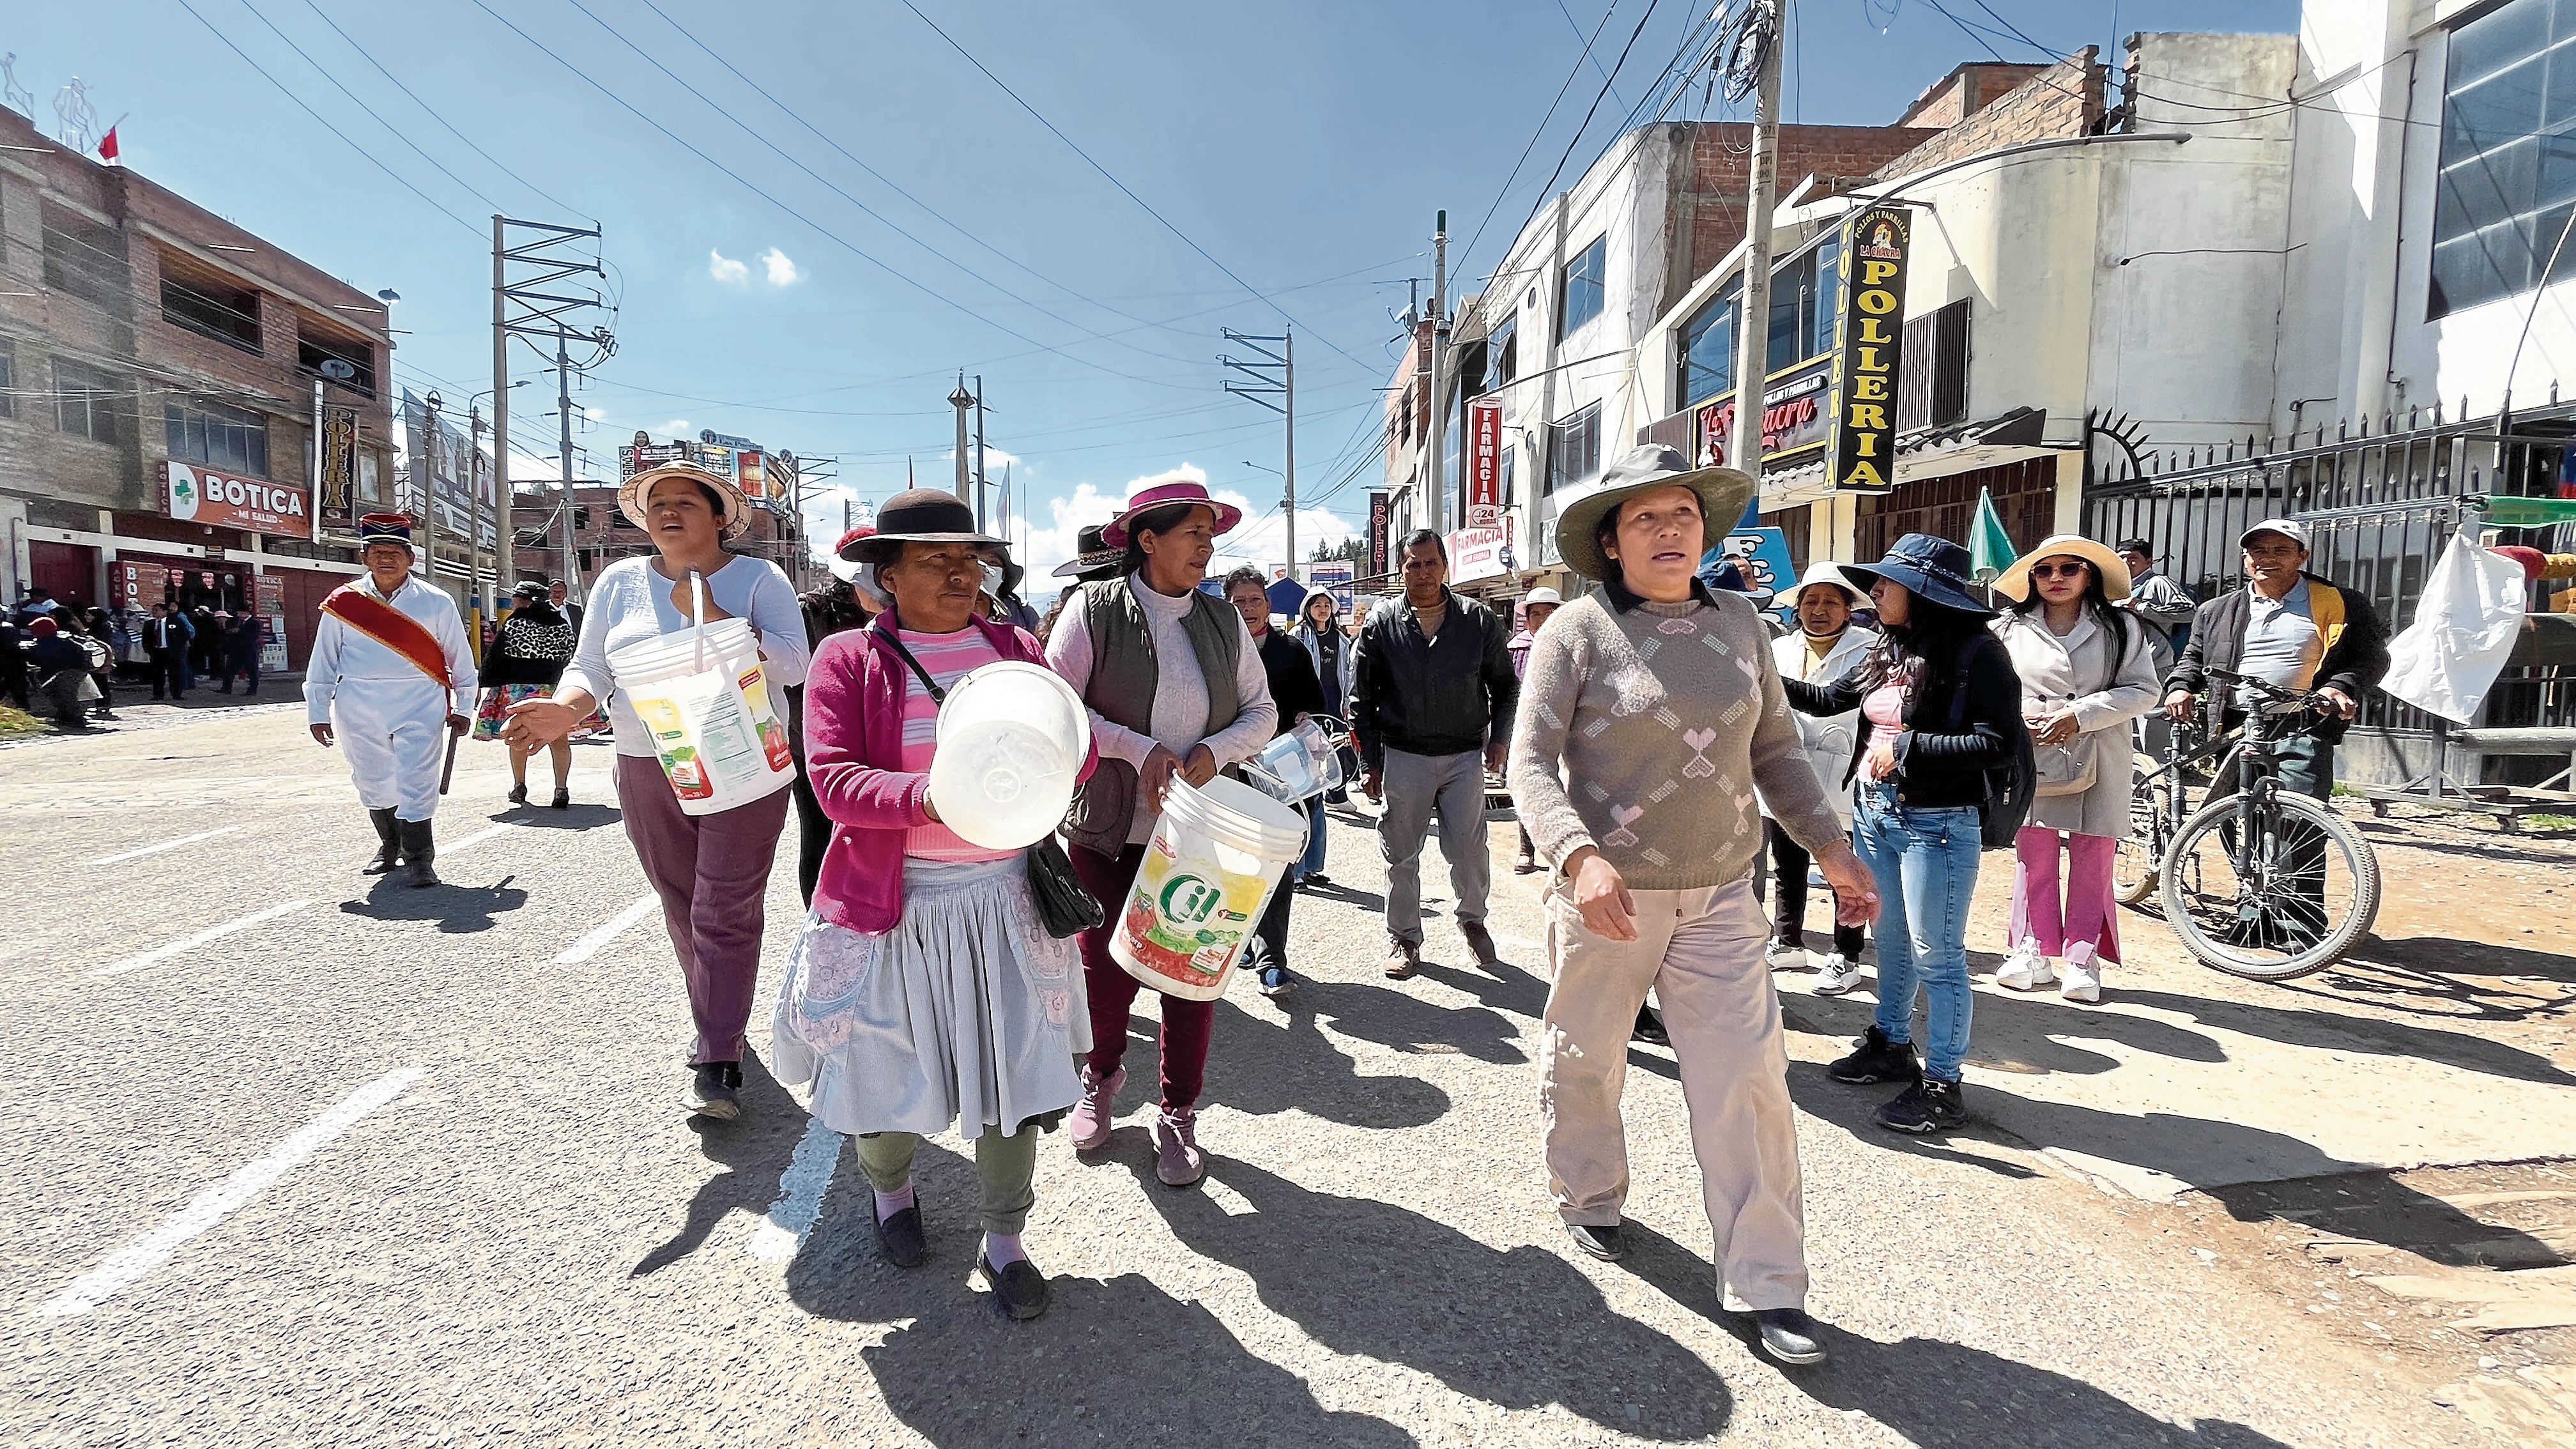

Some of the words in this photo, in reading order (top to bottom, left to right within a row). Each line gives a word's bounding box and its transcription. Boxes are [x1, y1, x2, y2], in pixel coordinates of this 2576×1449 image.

[1825, 220, 1853, 487] POLLERIA
[1842, 260, 1898, 486] POLLERIA
[1478, 410, 1494, 503] FARMACIA
[206, 474, 303, 517] BOTICA
[1481, 509, 1494, 518] 24
[252, 512, 278, 524] SALUD
[1457, 526, 1503, 552] FARMACIA
